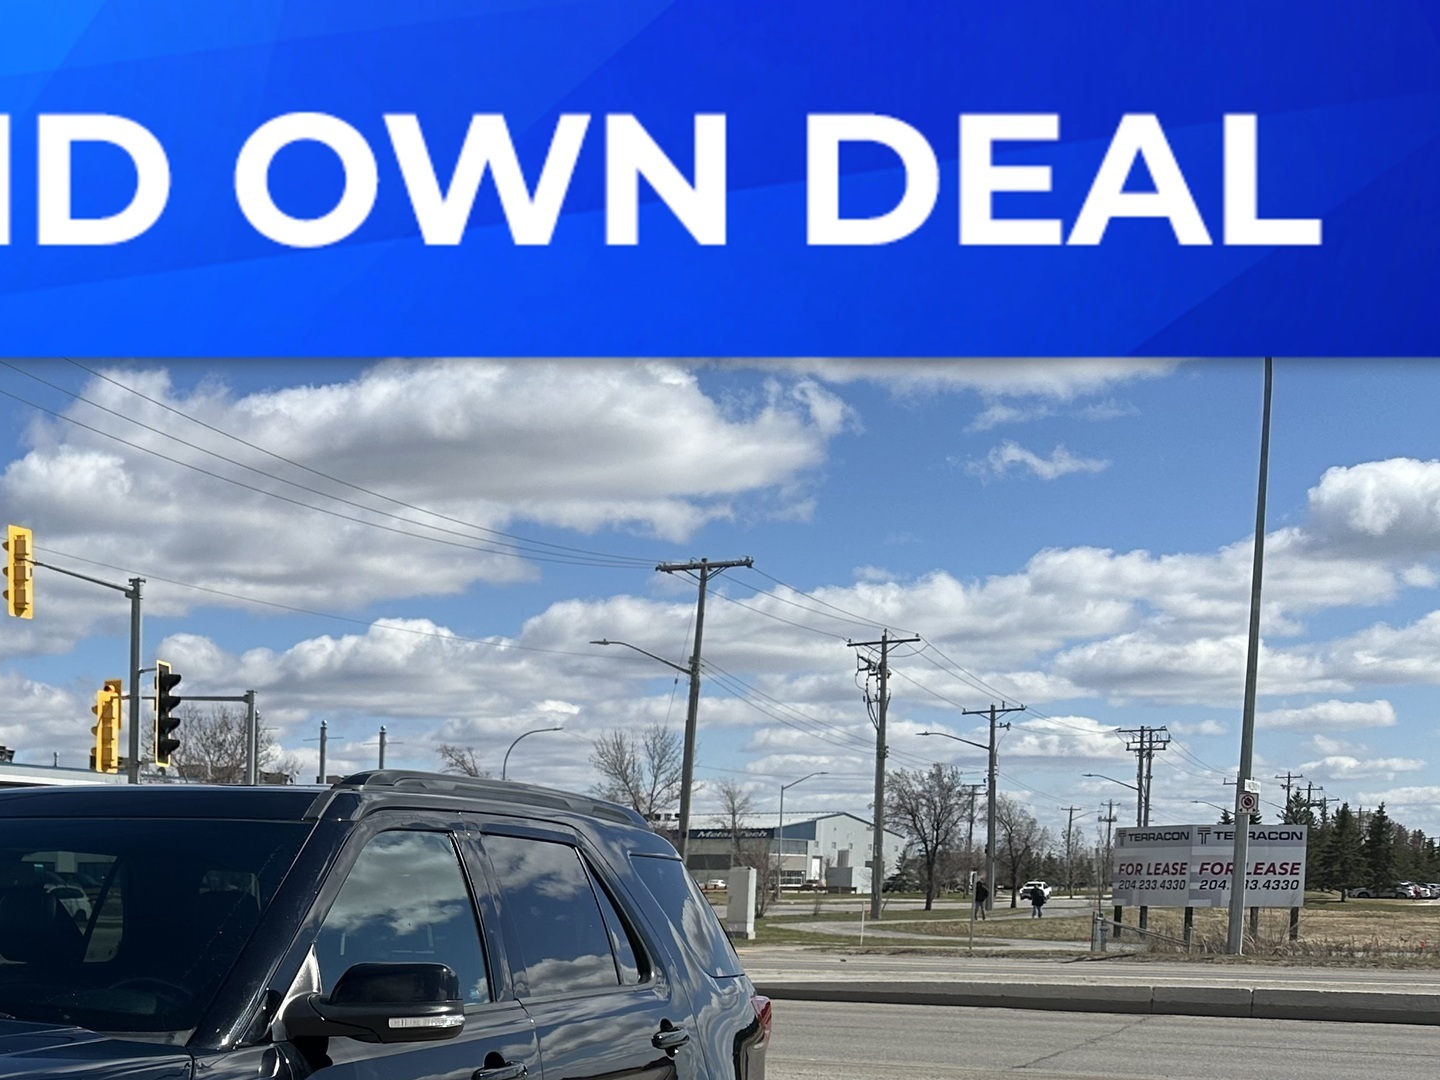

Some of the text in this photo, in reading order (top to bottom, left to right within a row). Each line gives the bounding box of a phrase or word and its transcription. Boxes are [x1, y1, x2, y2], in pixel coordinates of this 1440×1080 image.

[1128, 831, 1190, 842] TERRACON
[1213, 831, 1303, 840] TERACON
[1118, 861, 1188, 876] FOR LEASE
[1199, 862, 1302, 876] FOR LEASE
[1119, 879, 1186, 891] 204.233.4330
